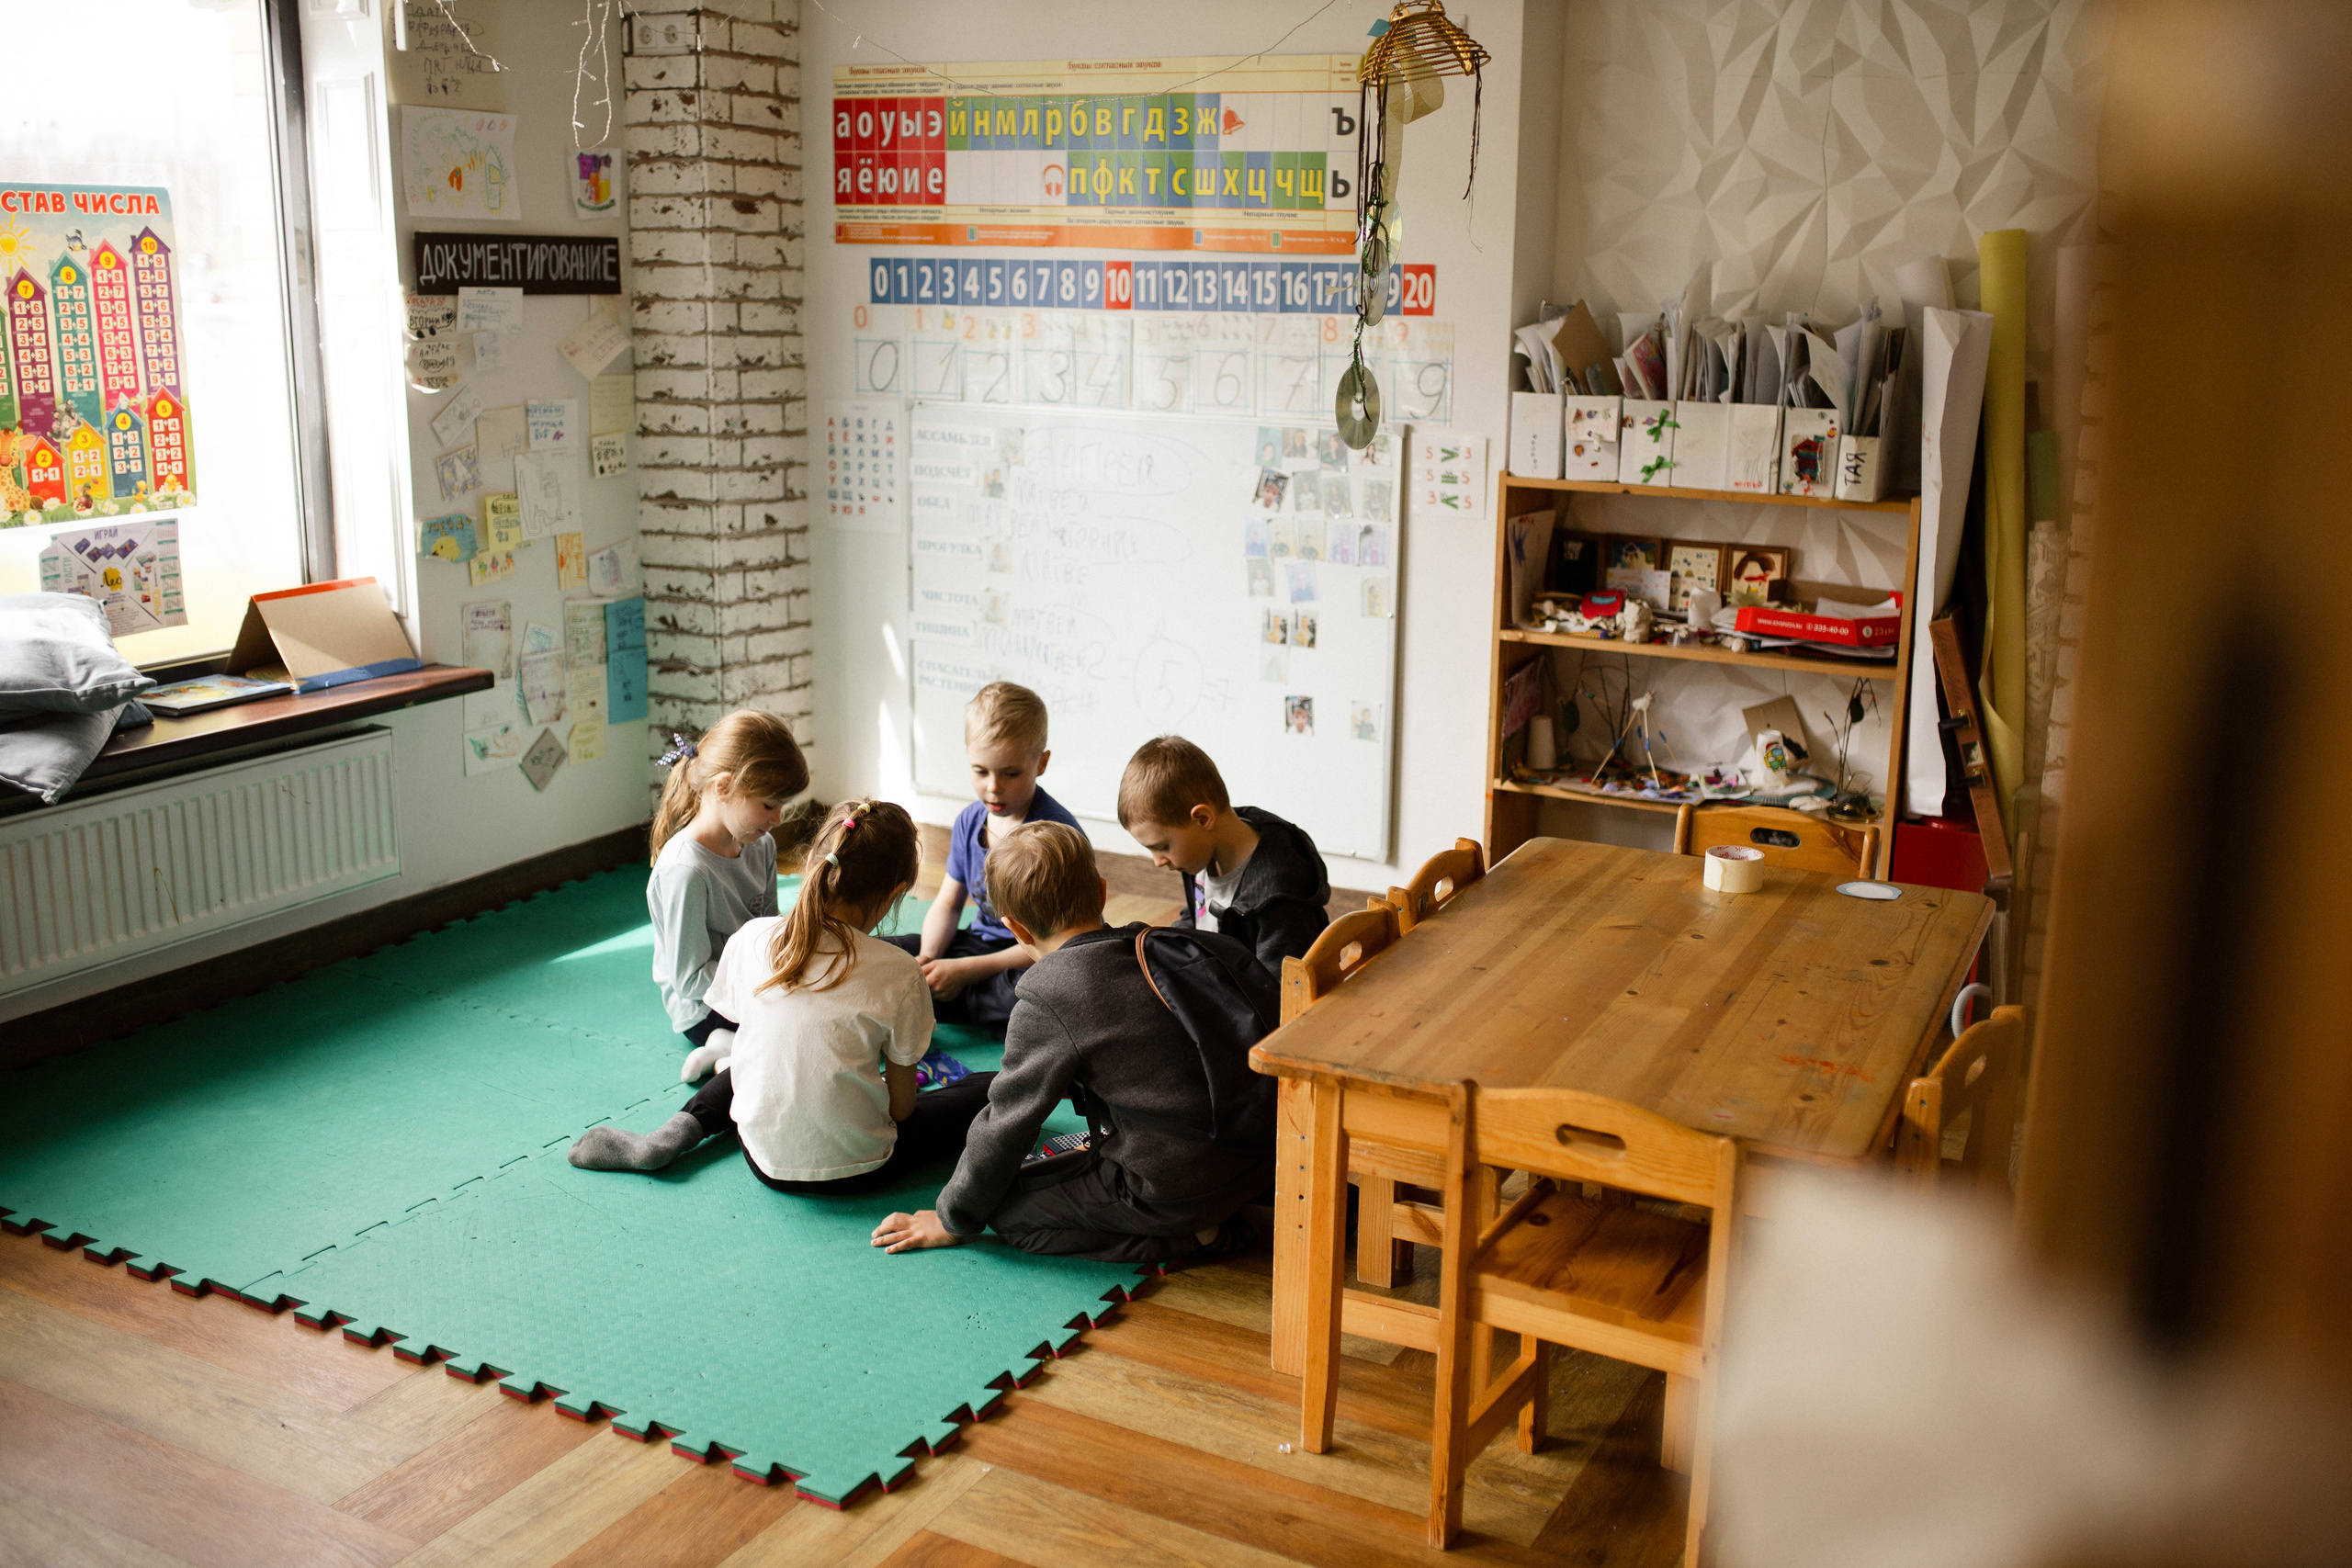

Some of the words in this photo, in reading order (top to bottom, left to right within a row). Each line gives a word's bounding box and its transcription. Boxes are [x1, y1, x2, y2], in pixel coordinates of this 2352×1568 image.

[74, 192, 160, 215] ЧИСЛА
[142, 242, 156, 251] 10
[105, 256, 111, 265] 9
[420, 243, 617, 286] ДОКУМЕНТИРОВАНИЕ
[65, 271, 73, 281] 8
[22, 286, 29, 295] 7
[875, 265, 888, 297] 0
[897, 266, 908, 297] 1
[921, 265, 933, 298] 2
[943, 265, 956, 299] 3
[964, 266, 979, 299] 4
[989, 267, 1002, 299] 5
[1012, 267, 1027, 299] 6
[1036, 268, 1050, 299] 7
[1060, 268, 1076, 301] 8
[1085, 268, 1100, 301] 9
[1107, 269, 1131, 301] 10
[1136, 270, 1157, 303] 11
[1163, 270, 1188, 303] 12
[1194, 270, 1217, 304] 13
[1223, 271, 1248, 304] 14
[1252, 271, 1276, 304] 15
[1282, 272, 1307, 305] 16
[1313, 272, 1339, 306] 17
[1404, 274, 1433, 309] 20
[854, 306, 868, 329] 0
[916, 307, 922, 329] 1
[964, 316, 976, 339] 2
[1023, 313, 1036, 337] 3
[1324, 317, 1338, 342] 8
[868, 341, 899, 391] 0
[982, 353, 1010, 402] 2
[1410, 363, 1448, 420] 9
[161, 404, 168, 413] 5
[120, 417, 127, 426] 4
[81, 434, 89, 444] 3
[40, 454, 48, 463] 2
[1844, 451, 1868, 487] ТАЯ
[94, 526, 119, 540] ИГРАЙ
[917, 539, 983, 555] ПРОГУЛКА
[921, 589, 979, 606] ЧИСТОТА
[915, 621, 970, 637] ТИШИНА
